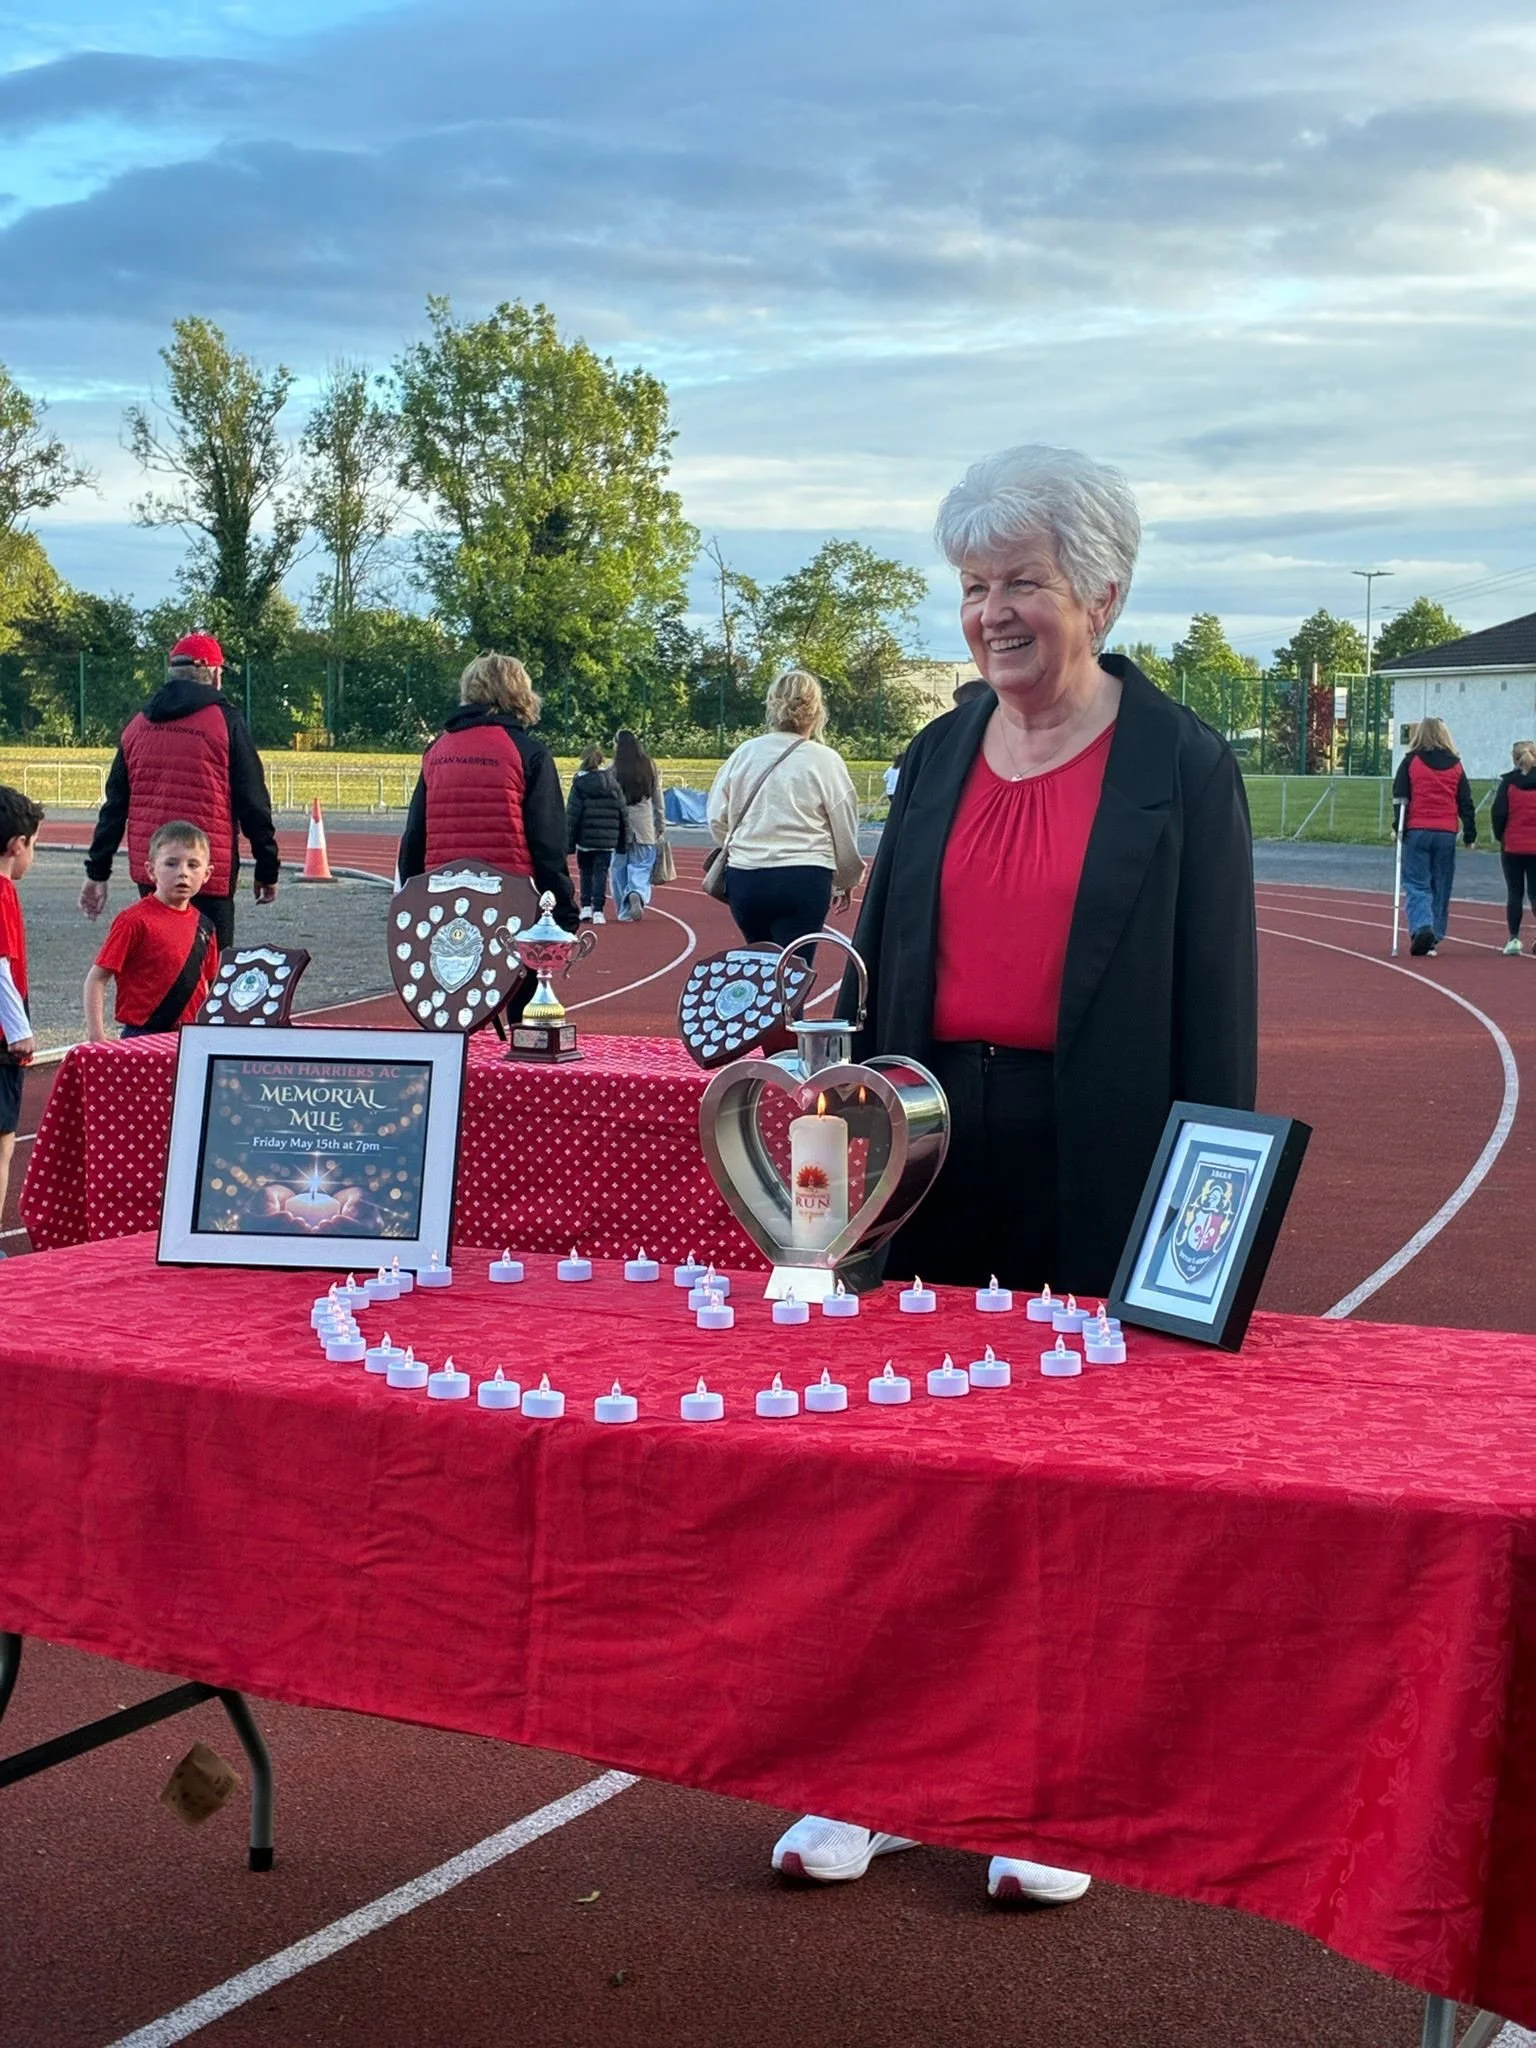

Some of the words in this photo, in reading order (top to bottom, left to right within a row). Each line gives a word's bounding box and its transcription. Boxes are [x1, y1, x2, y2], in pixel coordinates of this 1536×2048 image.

[242, 1062, 293, 1075] LUCAN
[298, 1063, 375, 1078] HARRIERS
[379, 1066, 400, 1079] AC
[260, 1084, 388, 1109] MEMORIAL
[288, 1108, 345, 1132] MILE
[253, 1137, 287, 1150] Friday
[290, 1138, 313, 1151] May
[316, 1139, 340, 1149] 15th
[343, 1141, 353, 1150] at
[356, 1140, 380, 1152] 7pm
[796, 1196, 830, 1208] RUN
